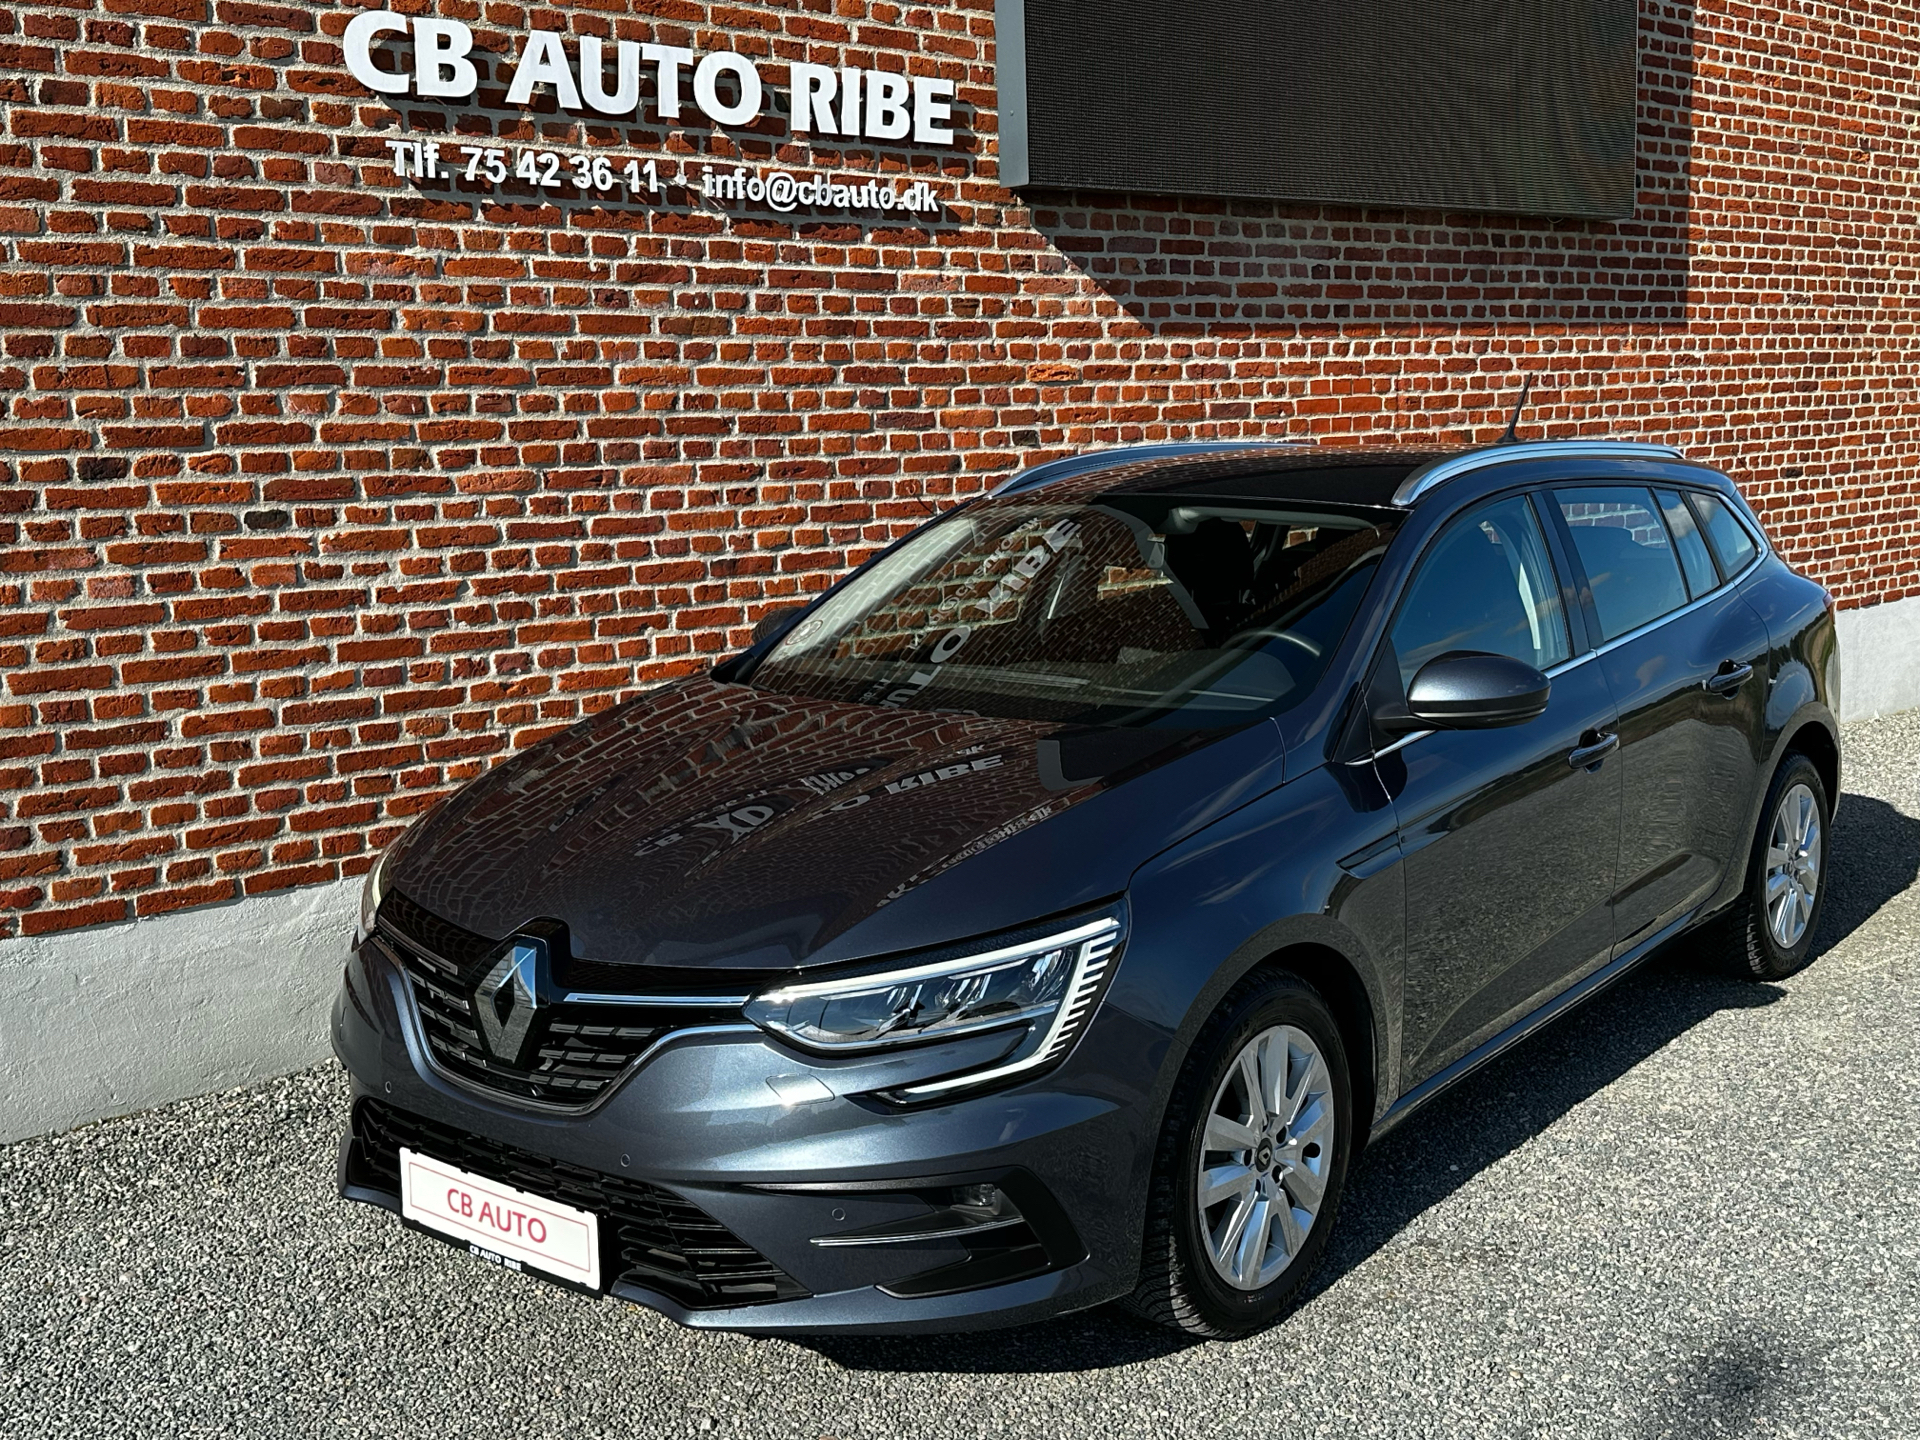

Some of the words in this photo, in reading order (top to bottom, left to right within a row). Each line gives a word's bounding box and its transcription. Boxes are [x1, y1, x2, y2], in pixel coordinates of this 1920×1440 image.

[343, 10, 478, 97] CB
[506, 30, 762, 125] AUTO
[790, 62, 954, 145] RIBE
[385, 141, 449, 179] Tlf.
[460, 146, 507, 184] 75
[516, 150, 561, 187] 42
[568, 155, 613, 191] 36
[624, 159, 658, 193] 11
[702, 166, 939, 212] info@cbauto.dk
[447, 1188, 473, 1218] CB
[478, 1201, 547, 1243] AUTO
[480, 1249, 502, 1264] AUTO
